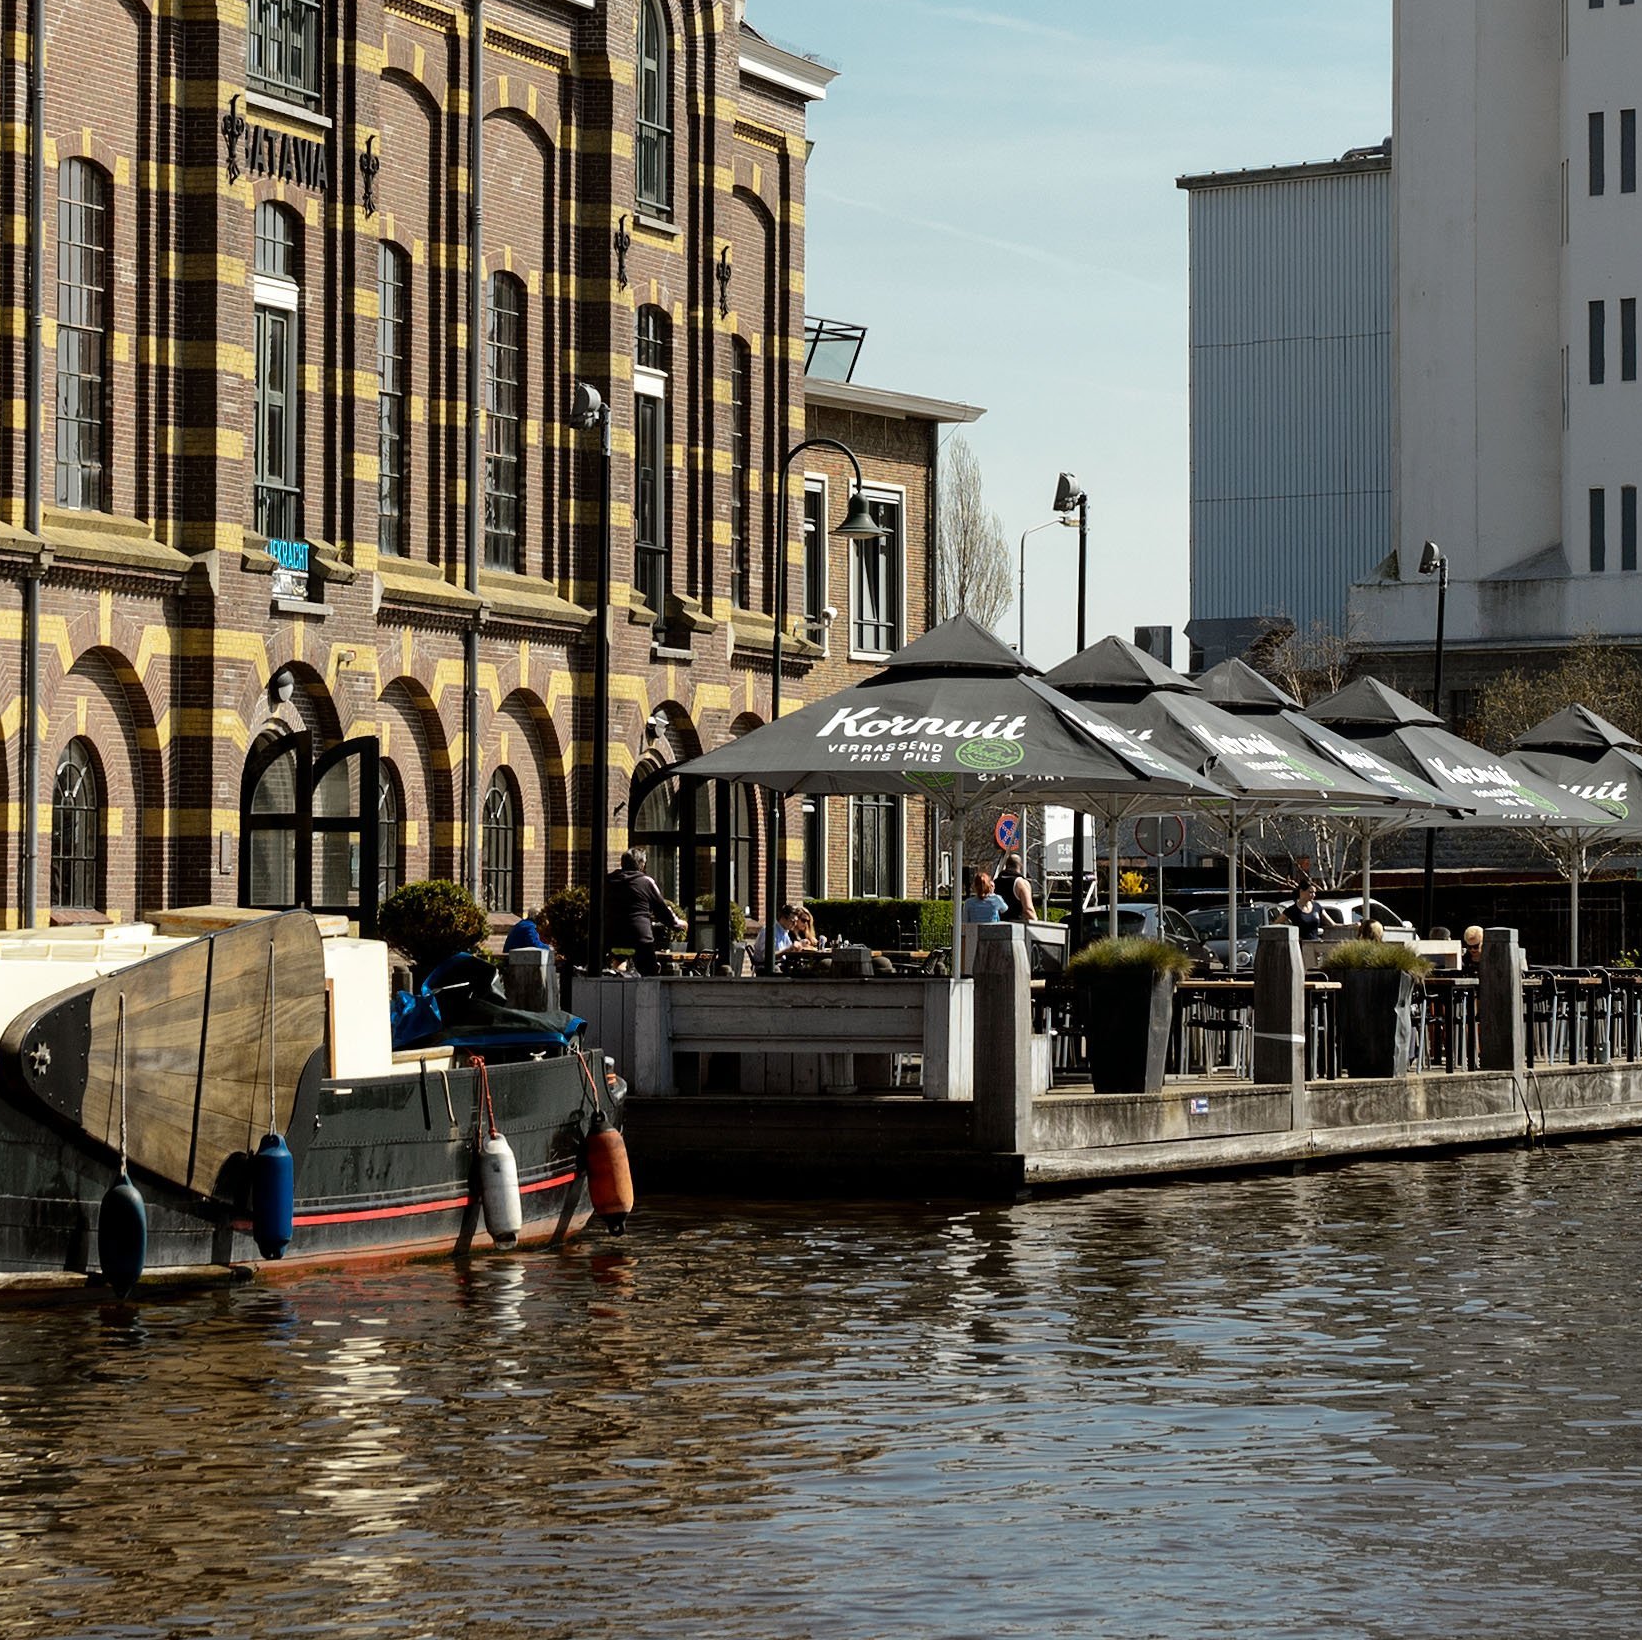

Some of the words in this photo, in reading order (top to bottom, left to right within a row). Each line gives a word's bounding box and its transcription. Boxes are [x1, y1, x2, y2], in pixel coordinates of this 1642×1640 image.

[815, 706, 1028, 741] Kornuit
[828, 740, 944, 753] VERRASSEND
[850, 752, 892, 762] FRIS
[903, 751, 942, 763] PILS
